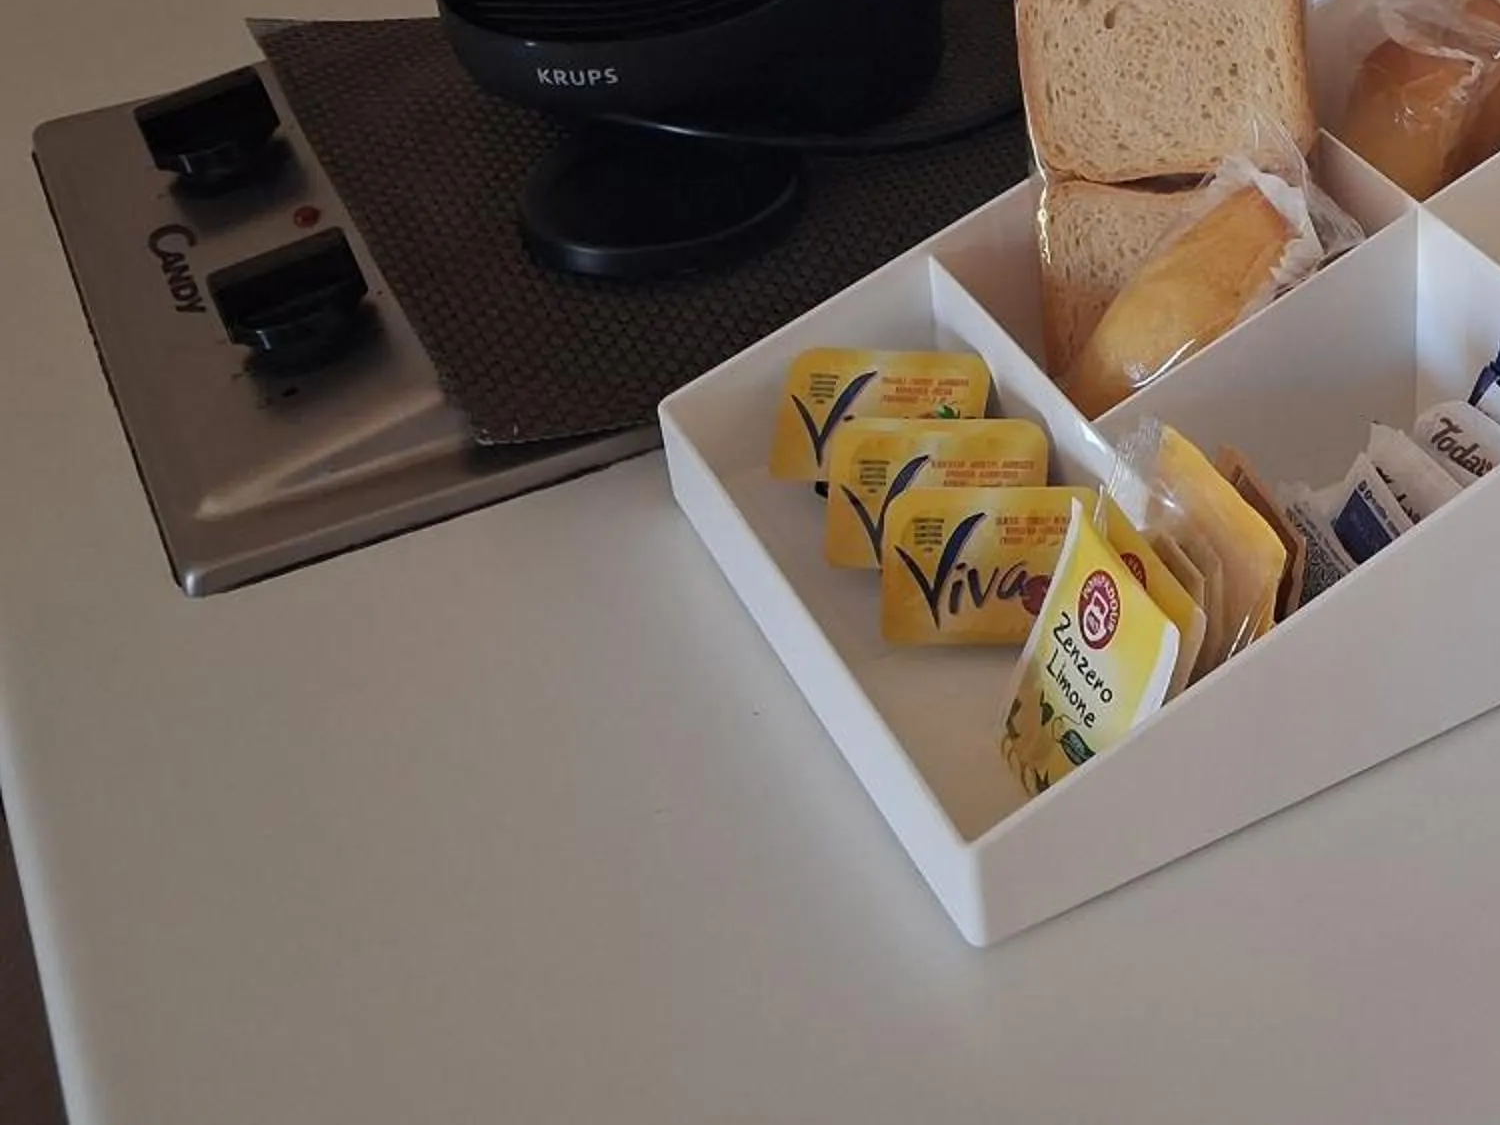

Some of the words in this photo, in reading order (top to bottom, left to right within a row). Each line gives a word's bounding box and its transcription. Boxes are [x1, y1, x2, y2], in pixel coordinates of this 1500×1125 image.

[537, 67, 619, 86] KRUPS
[893, 511, 1029, 631] Viva
[1046, 648, 1097, 728] Limone
[1053, 610, 1114, 704] Zenzero
